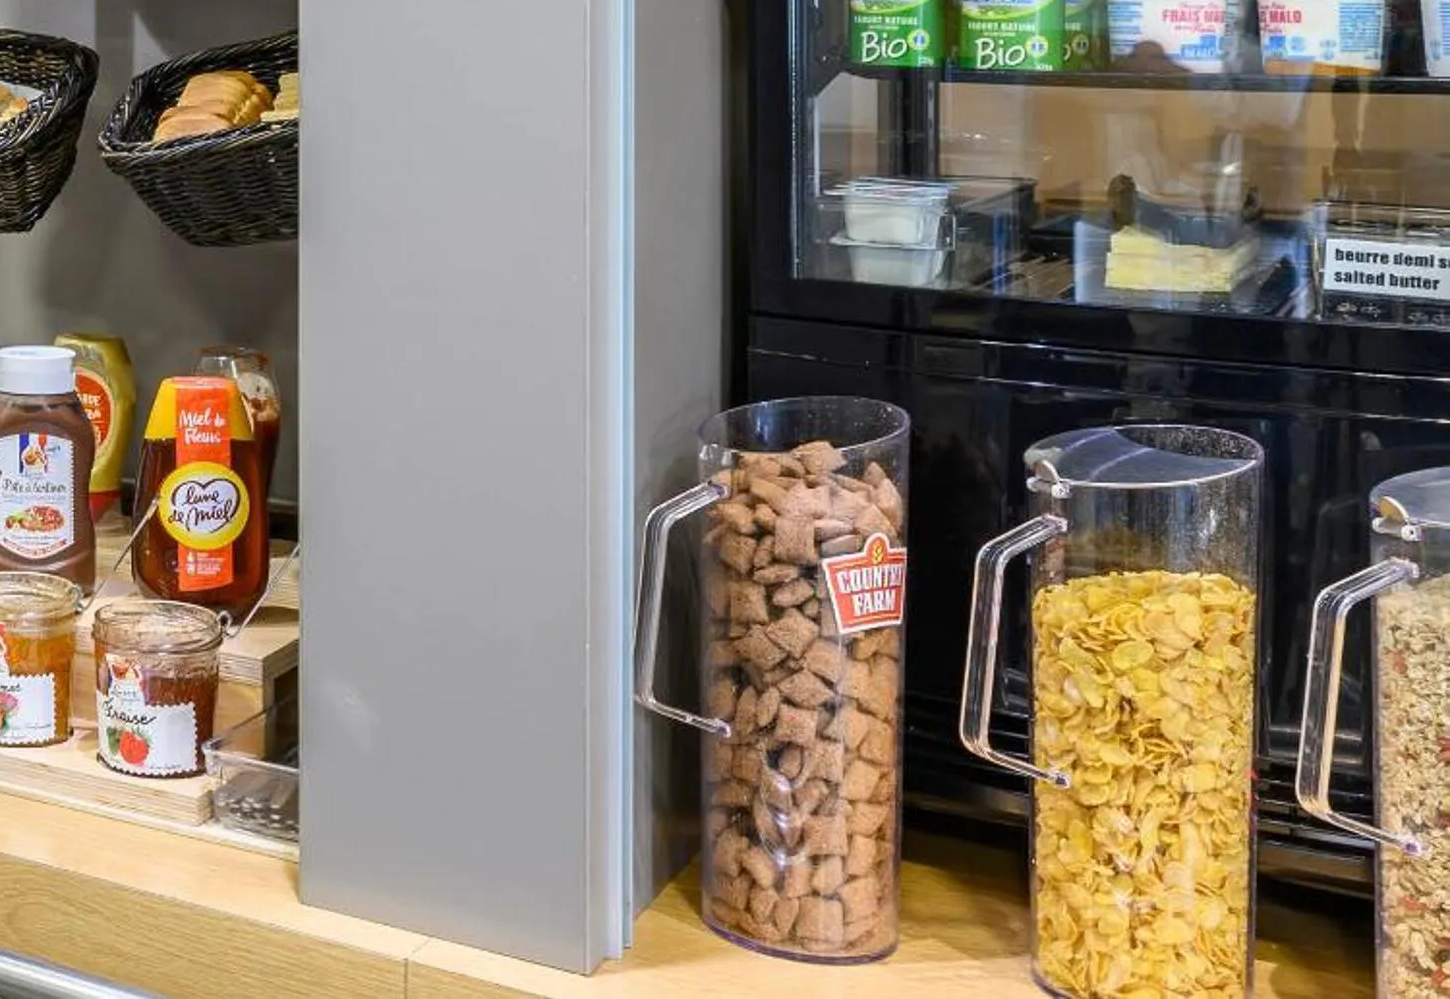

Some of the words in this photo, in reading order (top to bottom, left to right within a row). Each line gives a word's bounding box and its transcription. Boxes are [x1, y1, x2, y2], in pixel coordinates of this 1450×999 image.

[861, 31, 908, 62] Bio
[974, 37, 1026, 69] Bio
[1335, 248, 1389, 265] beurre
[1393, 252, 1434, 268] demi
[1334, 270, 1385, 286] salted
[1389, 273, 1440, 290] butter
[179, 408, 212, 428] Miel
[214, 411, 225, 427] de
[184, 427, 221, 444] Fleurs
[852, 590, 896, 616] FARM
